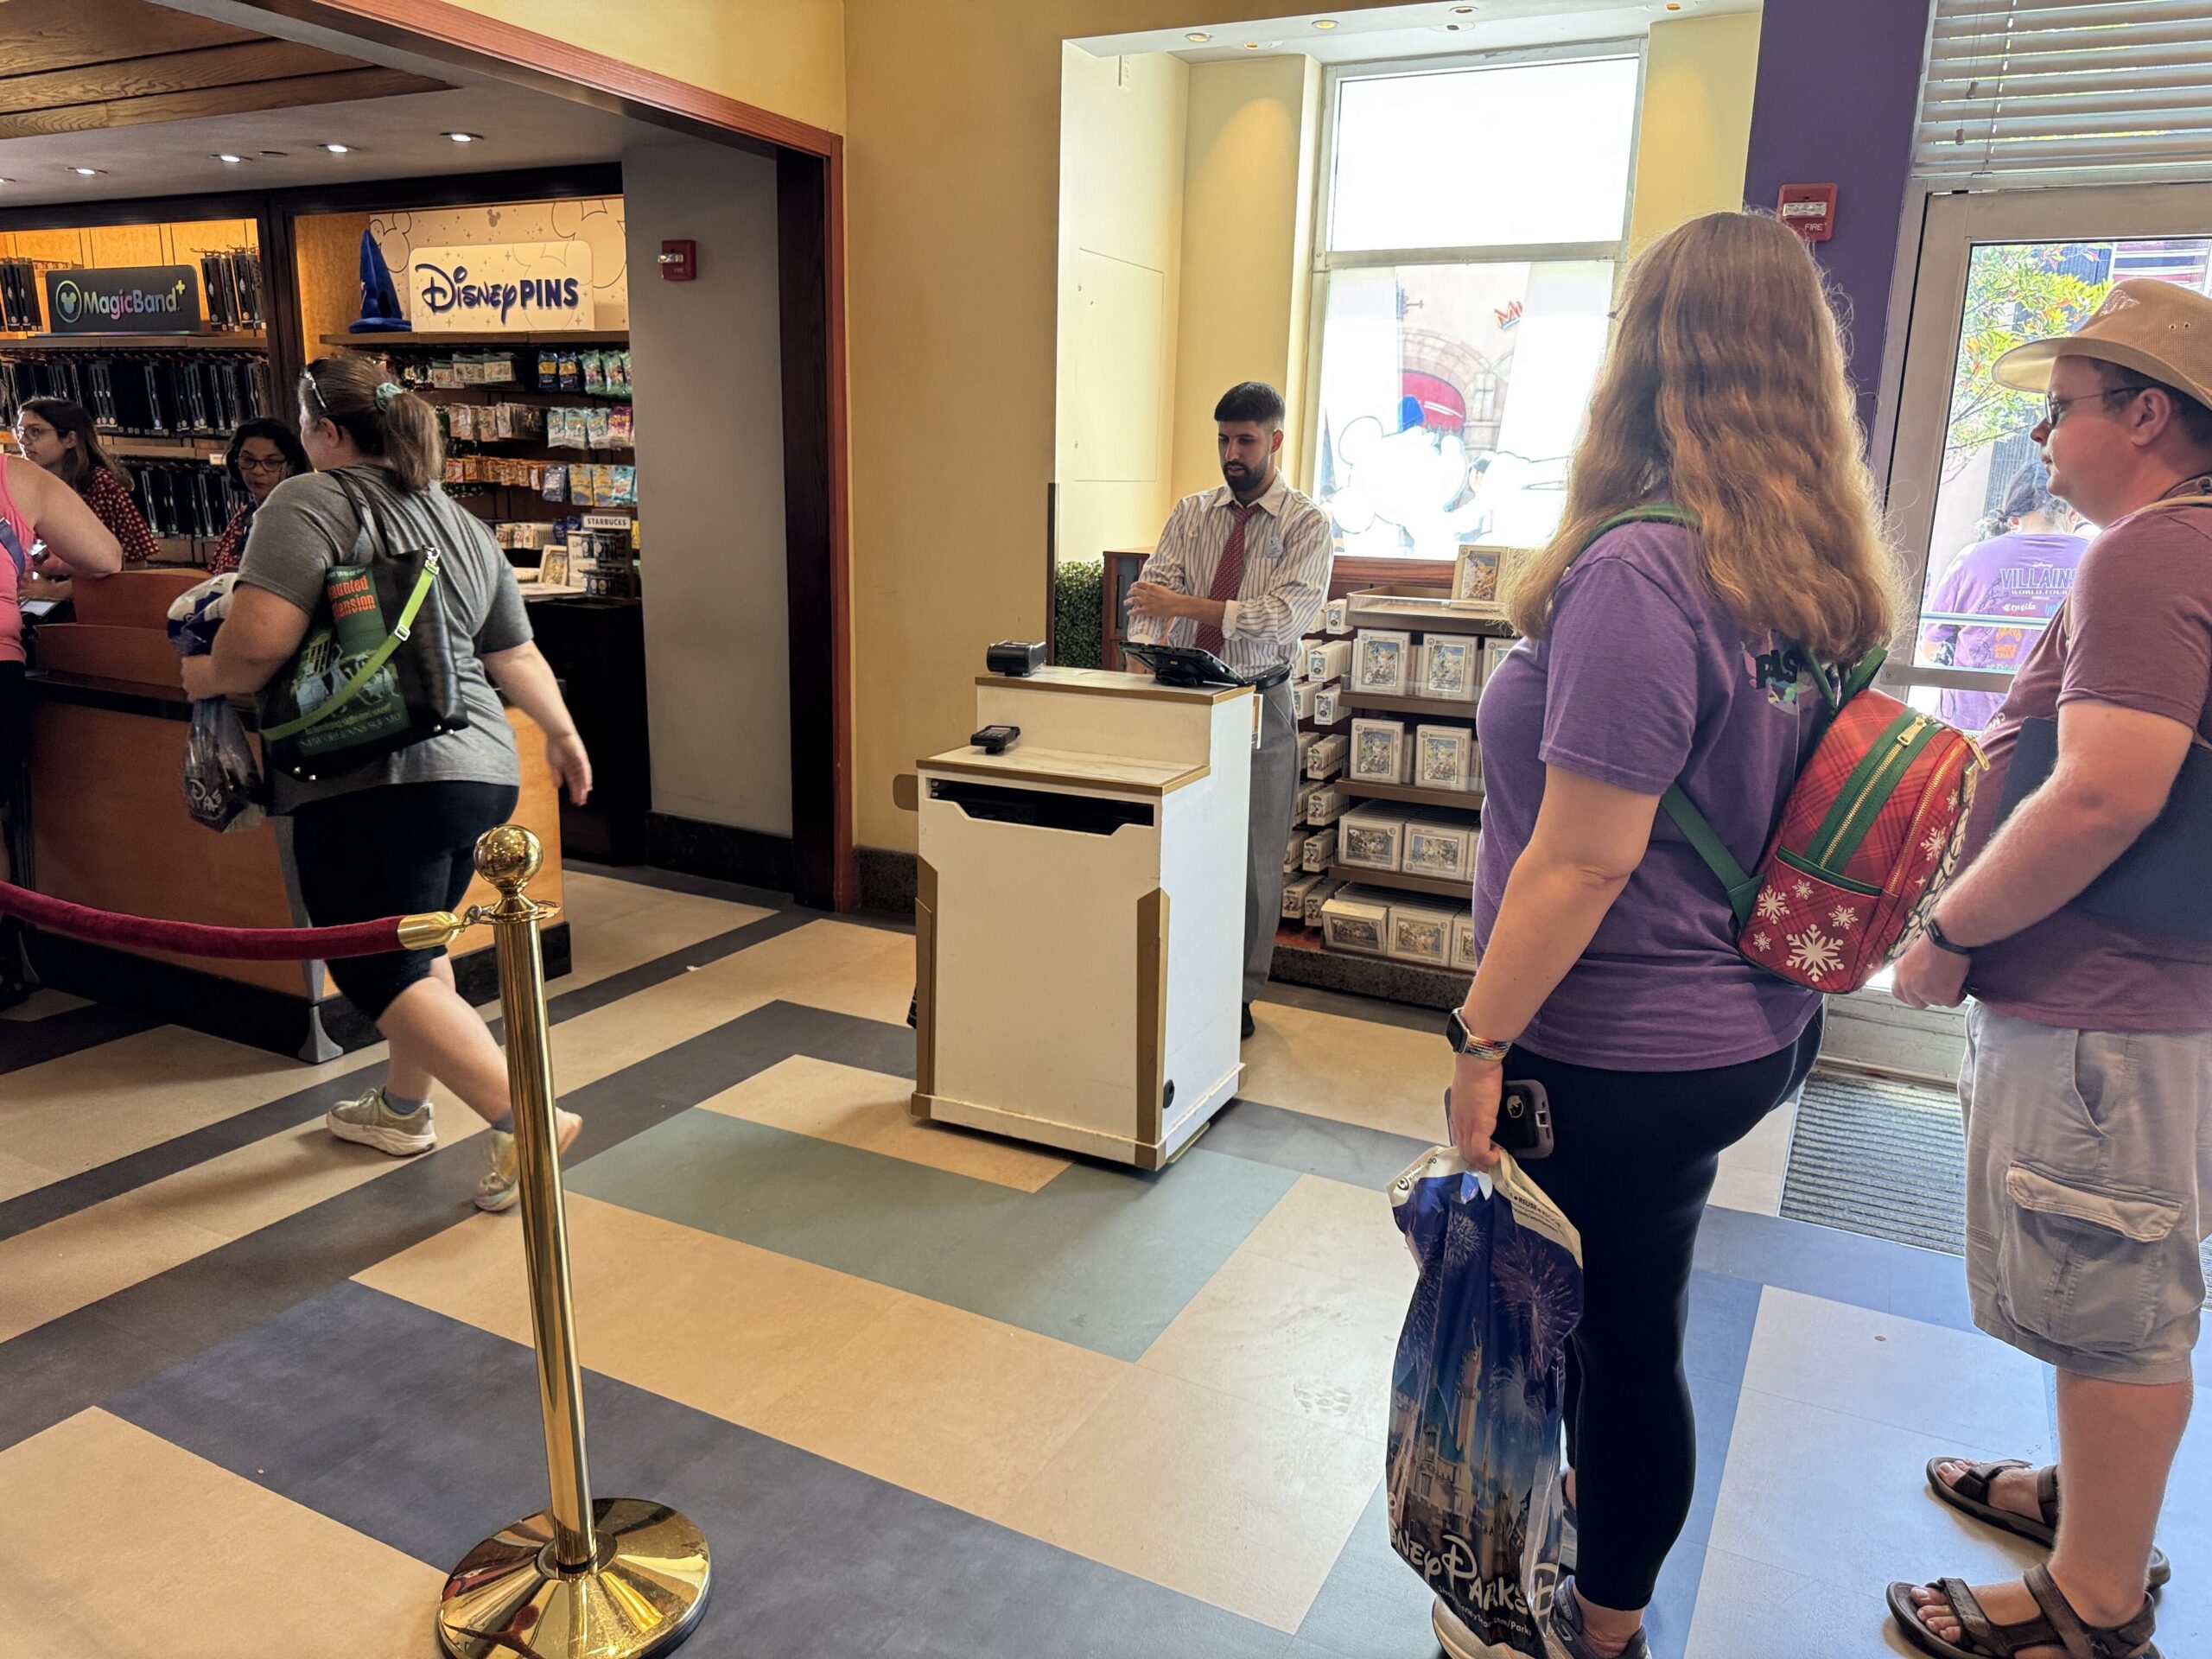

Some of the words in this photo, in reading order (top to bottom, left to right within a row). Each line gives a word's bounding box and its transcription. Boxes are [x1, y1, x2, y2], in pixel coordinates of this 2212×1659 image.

[1804, 223, 1824, 232] FIRE
[519, 277, 579, 310] PINS
[587, 518, 626, 527] STARBUCKS
[327, 574, 370, 600] aunted
